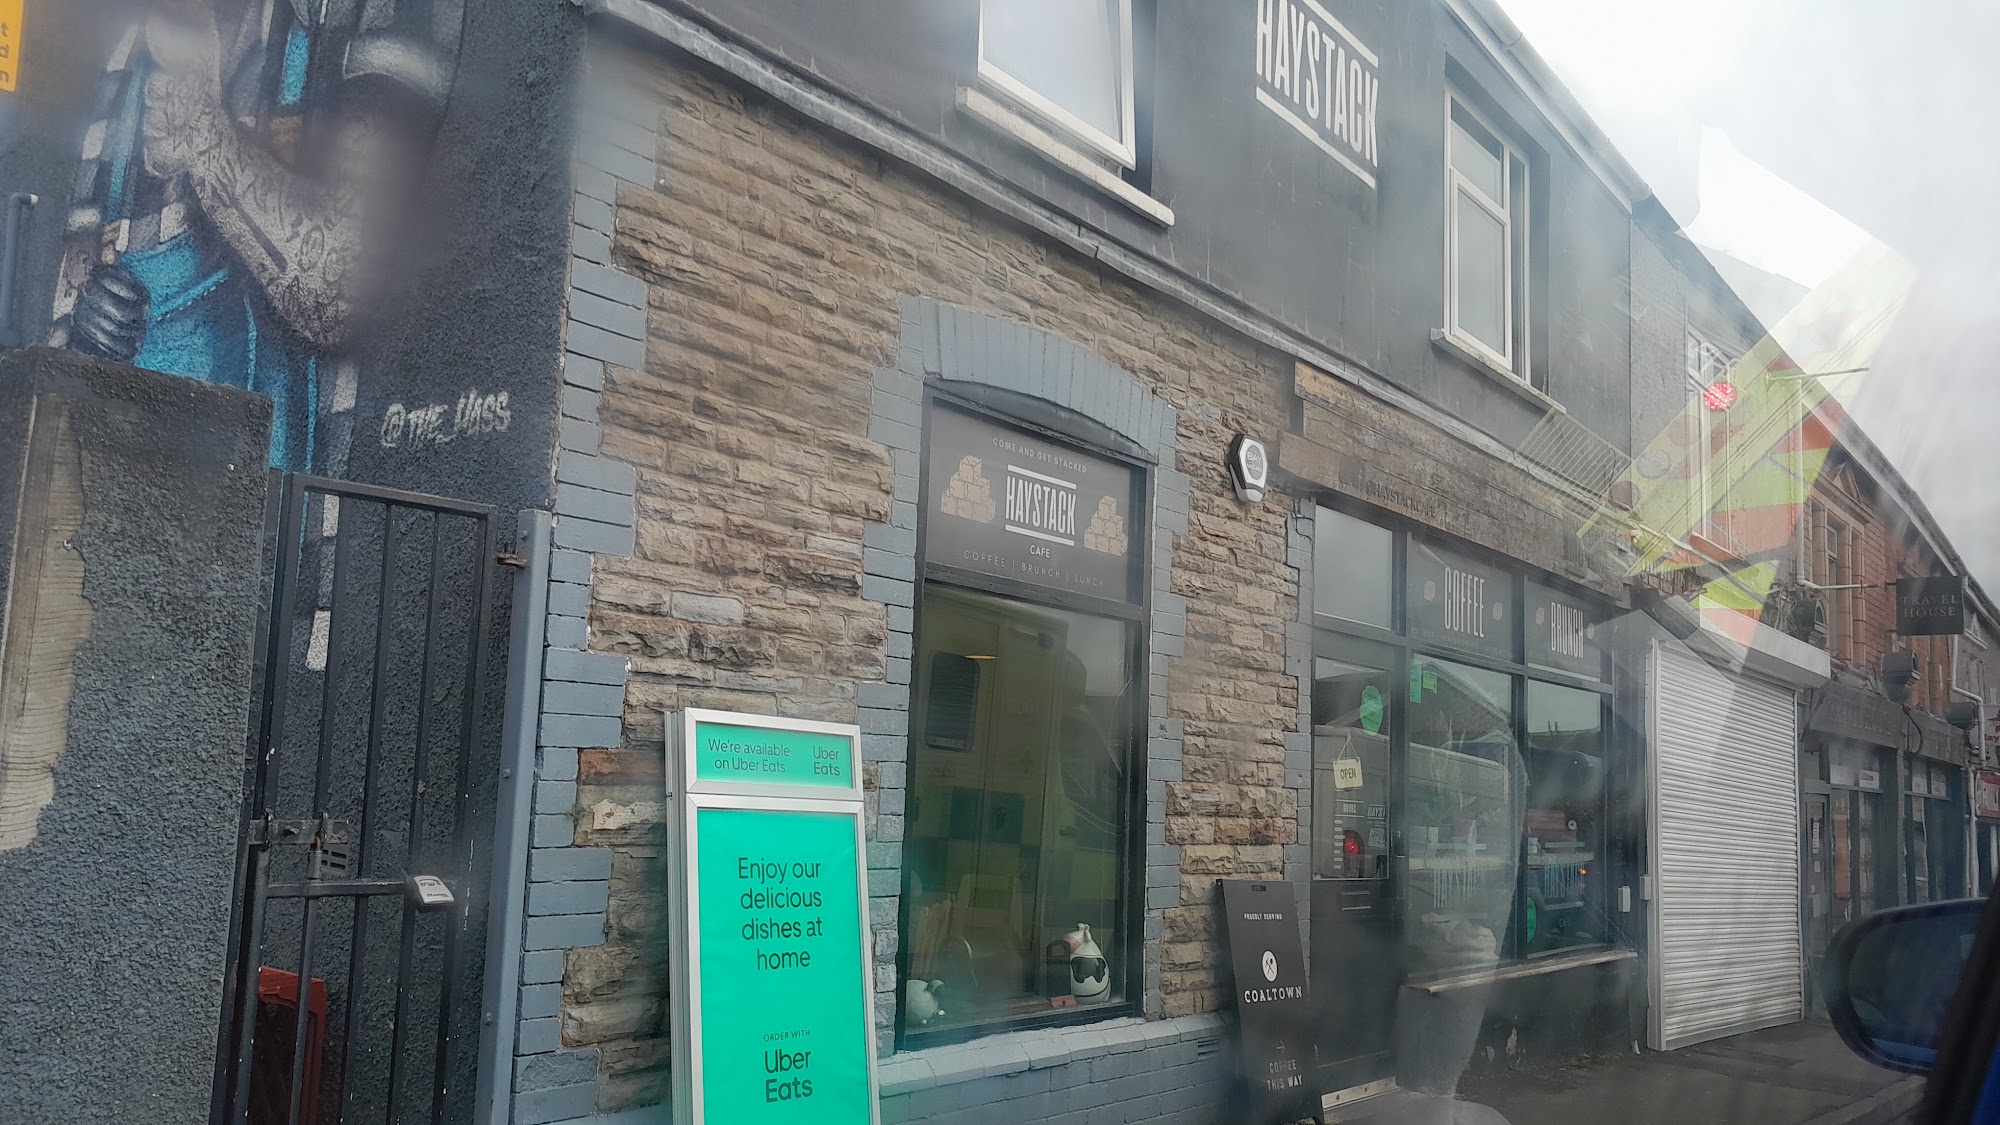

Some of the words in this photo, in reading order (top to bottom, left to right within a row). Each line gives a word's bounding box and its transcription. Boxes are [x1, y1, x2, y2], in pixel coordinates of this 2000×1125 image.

[1256, 0, 1379, 169] HAYSTACK
[992, 437, 1016, 453] COME
[1019, 446, 1035, 459] AND
[1037, 451, 1051, 464] GET
[1054, 453, 1088, 474] STACKED
[1005, 475, 1077, 536] HAYSTACK
[1029, 545, 1051, 559] CAFE
[963, 549, 1006, 568] COFFEE
[1021, 560, 1061, 579] BRUNCH
[1074, 573, 1105, 588] LUNCH
[1444, 566, 1485, 638] COFFEE
[1904, 606, 1956, 618] HOUSE
[1551, 601, 1584, 659] BRUNCH
[707, 737, 741, 754] We're
[743, 743, 790, 758] available
[812, 745, 840, 761] Uber
[714, 758, 730, 770] on
[732, 756, 760, 772] Uber
[763, 759, 786, 774] Eats
[813, 761, 841, 777] Eats
[1340, 767, 1357, 780] OPEN
[738, 857, 788, 884] Enjoy
[792, 861, 821, 879] our
[740, 887, 822, 909] delicious
[741, 917, 802, 941] dishes
[806, 916, 823, 938] at
[756, 949, 811, 971] home
[1244, 985, 1303, 1004] COALTOWN
[763, 1031, 789, 1043] ORDER
[791, 1028, 811, 1040] WITH
[764, 1048, 812, 1074] Uber
[765, 1076, 814, 1103] Eats
[1266, 1077, 1285, 1091] THIS
[1287, 1073, 1303, 1088] WAY
